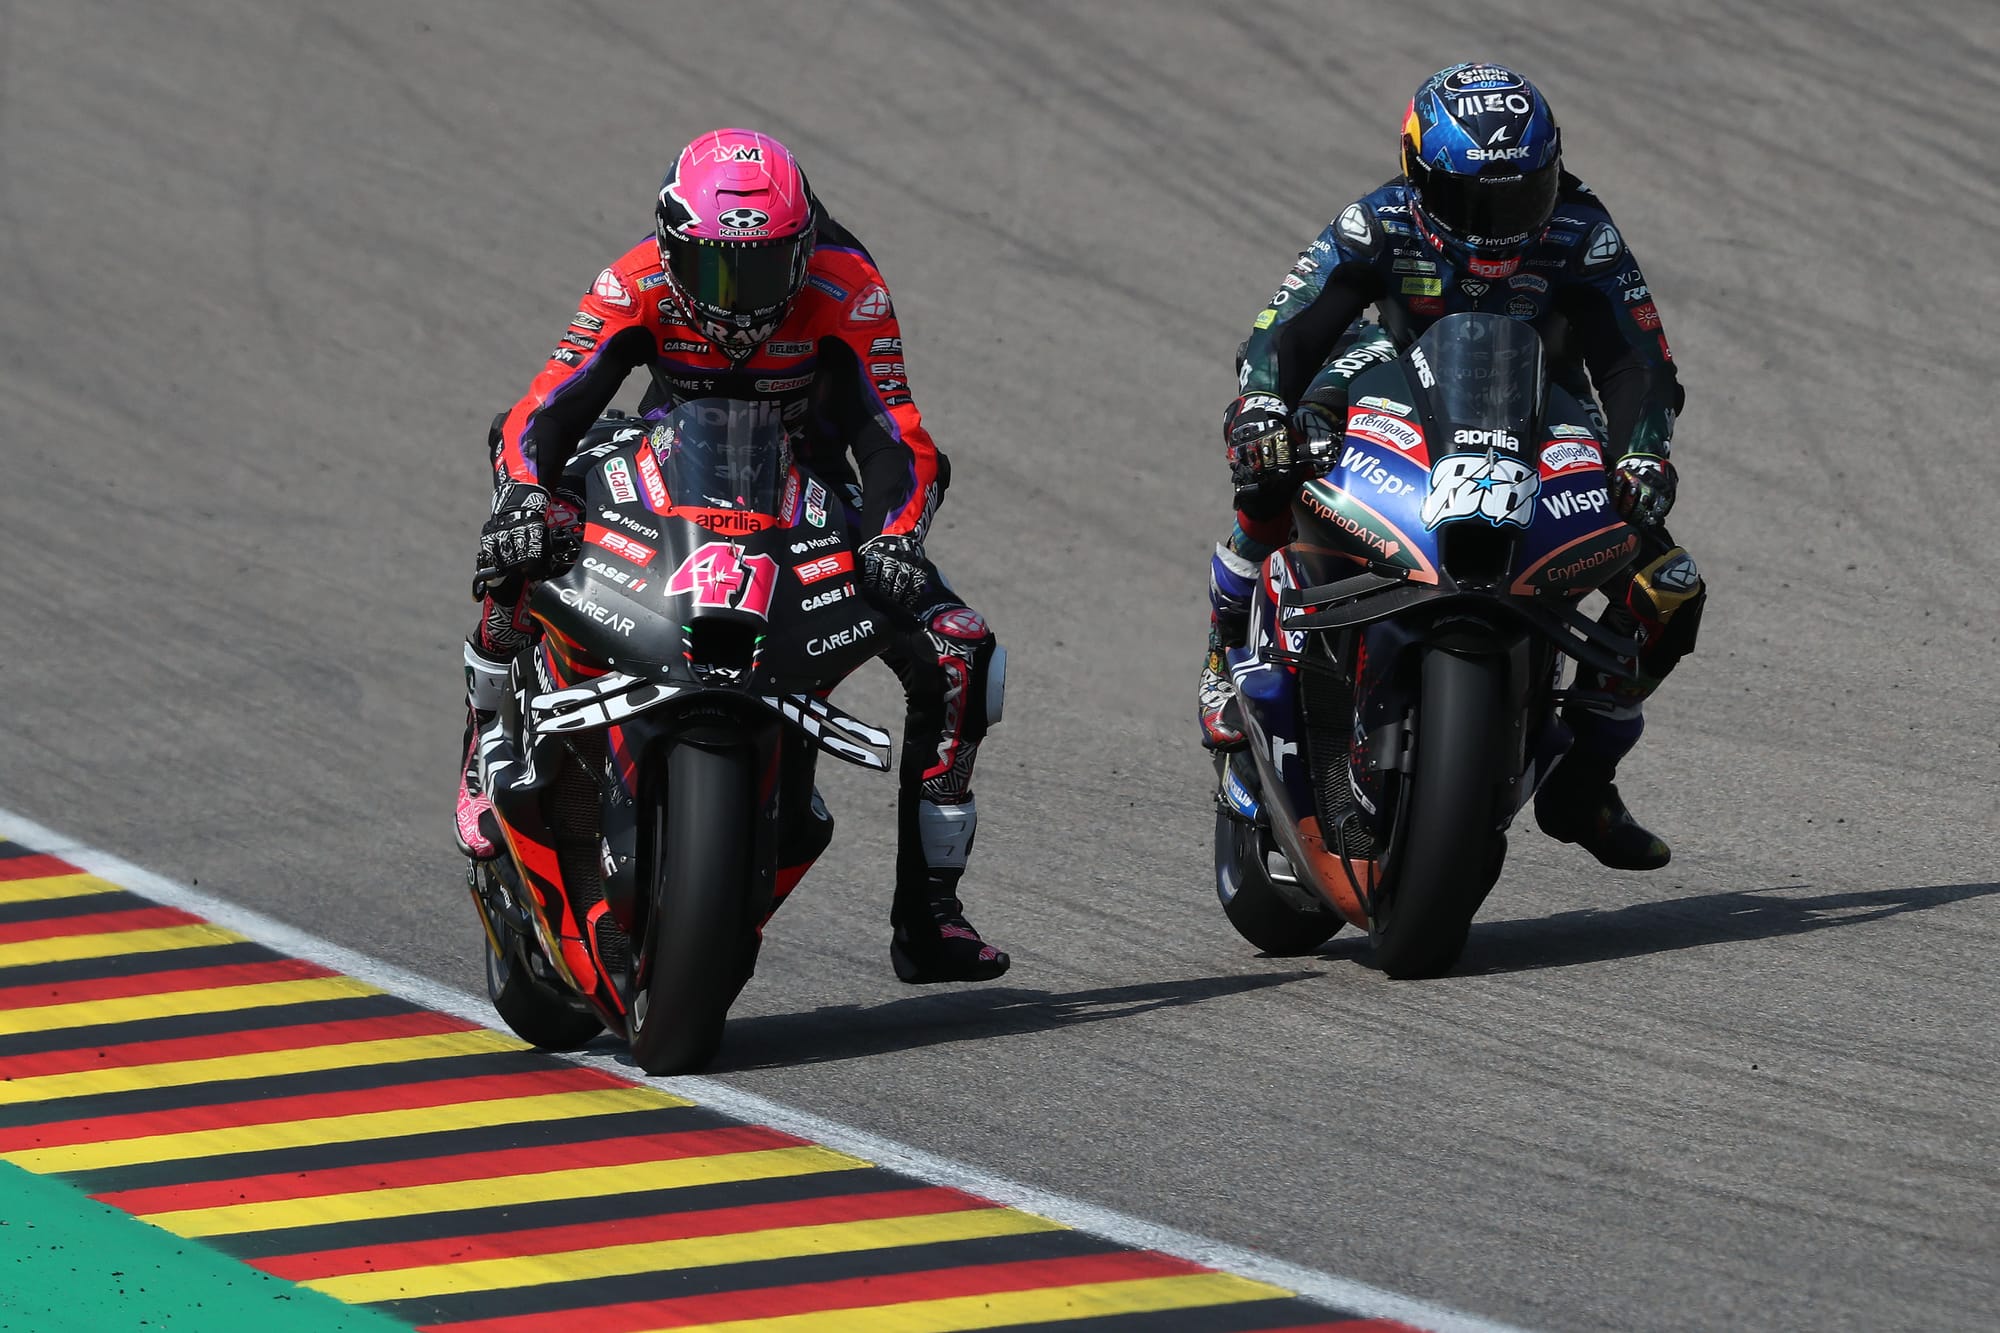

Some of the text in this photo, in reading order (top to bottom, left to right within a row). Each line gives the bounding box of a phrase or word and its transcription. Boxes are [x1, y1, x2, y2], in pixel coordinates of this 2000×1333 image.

[1466, 145, 1530, 161] SHARK
[718, 228, 769, 238] Kabuto
[1484, 232, 1529, 247] HYUNDAI
[1410, 345, 1435, 389] WRS
[1353, 415, 1416, 445] sterilgarda
[1454, 429, 1520, 452] aprilia
[1545, 443, 1599, 466] sterilgarda
[1340, 446, 1416, 497] Wispr
[1542, 487, 1609, 520] Wispr
[619, 516, 659, 539] Marsh
[696, 512, 762, 532] aprilia
[1301, 490, 1387, 554] CryptoDATA
[601, 532, 652, 559] BS
[806, 536, 841, 550] Marsh
[582, 557, 631, 585] CASE
[797, 556, 840, 579] BS
[1547, 541, 1630, 582] CryptoDATA
[664, 541, 779, 622] 41
[559, 588, 636, 637] CAREAR
[801, 588, 843, 612] CASE
[806, 620, 875, 656] CAREAR
